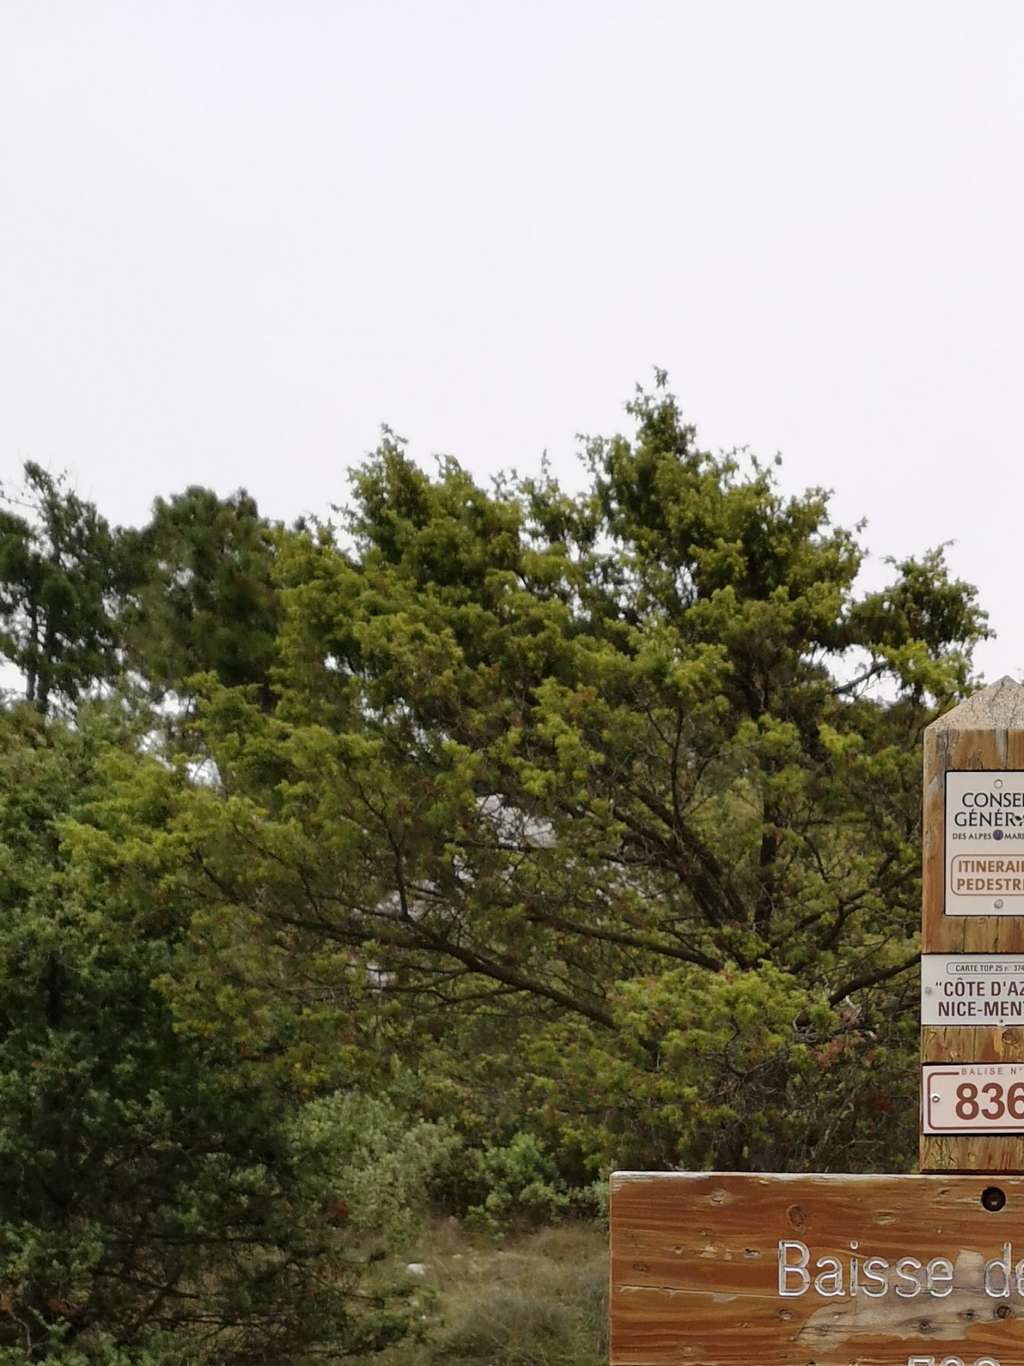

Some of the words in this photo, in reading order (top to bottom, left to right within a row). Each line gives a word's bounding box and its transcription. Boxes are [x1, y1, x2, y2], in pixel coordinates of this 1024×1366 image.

[952, 832, 967, 840] DES
[968, 832, 992, 840] ALPES
[955, 964, 978, 972] CARTE
[980, 964, 994, 972] TOP
[961, 1066, 1004, 1076] BALISE
[777, 1239, 954, 1299] Baisse
